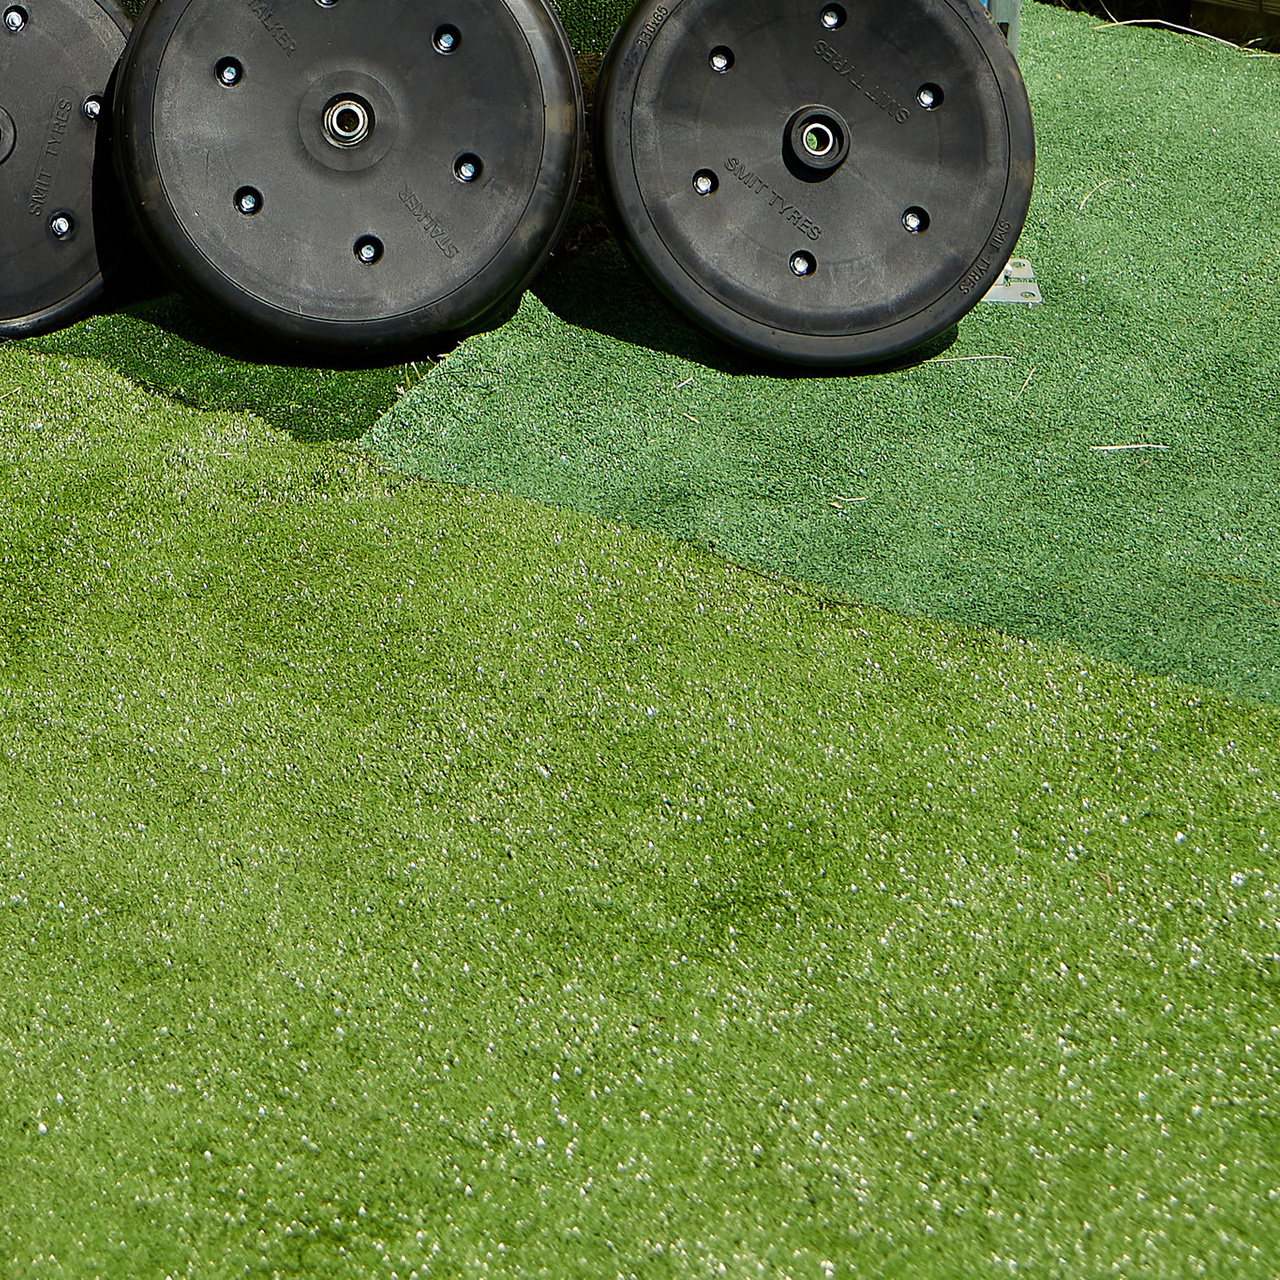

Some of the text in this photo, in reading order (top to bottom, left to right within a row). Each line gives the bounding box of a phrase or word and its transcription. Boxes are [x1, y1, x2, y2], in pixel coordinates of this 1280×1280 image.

[636, 5, 669, 48] 330x65
[813, 38, 911, 124] SMIT TYRES
[27, 98, 73, 218] SMIT TYRES
[398, 184, 460, 259] STALKER
[724, 157, 822, 241] SMIT TYRES
[958, 219, 1011, 295] SMIT TYRES
